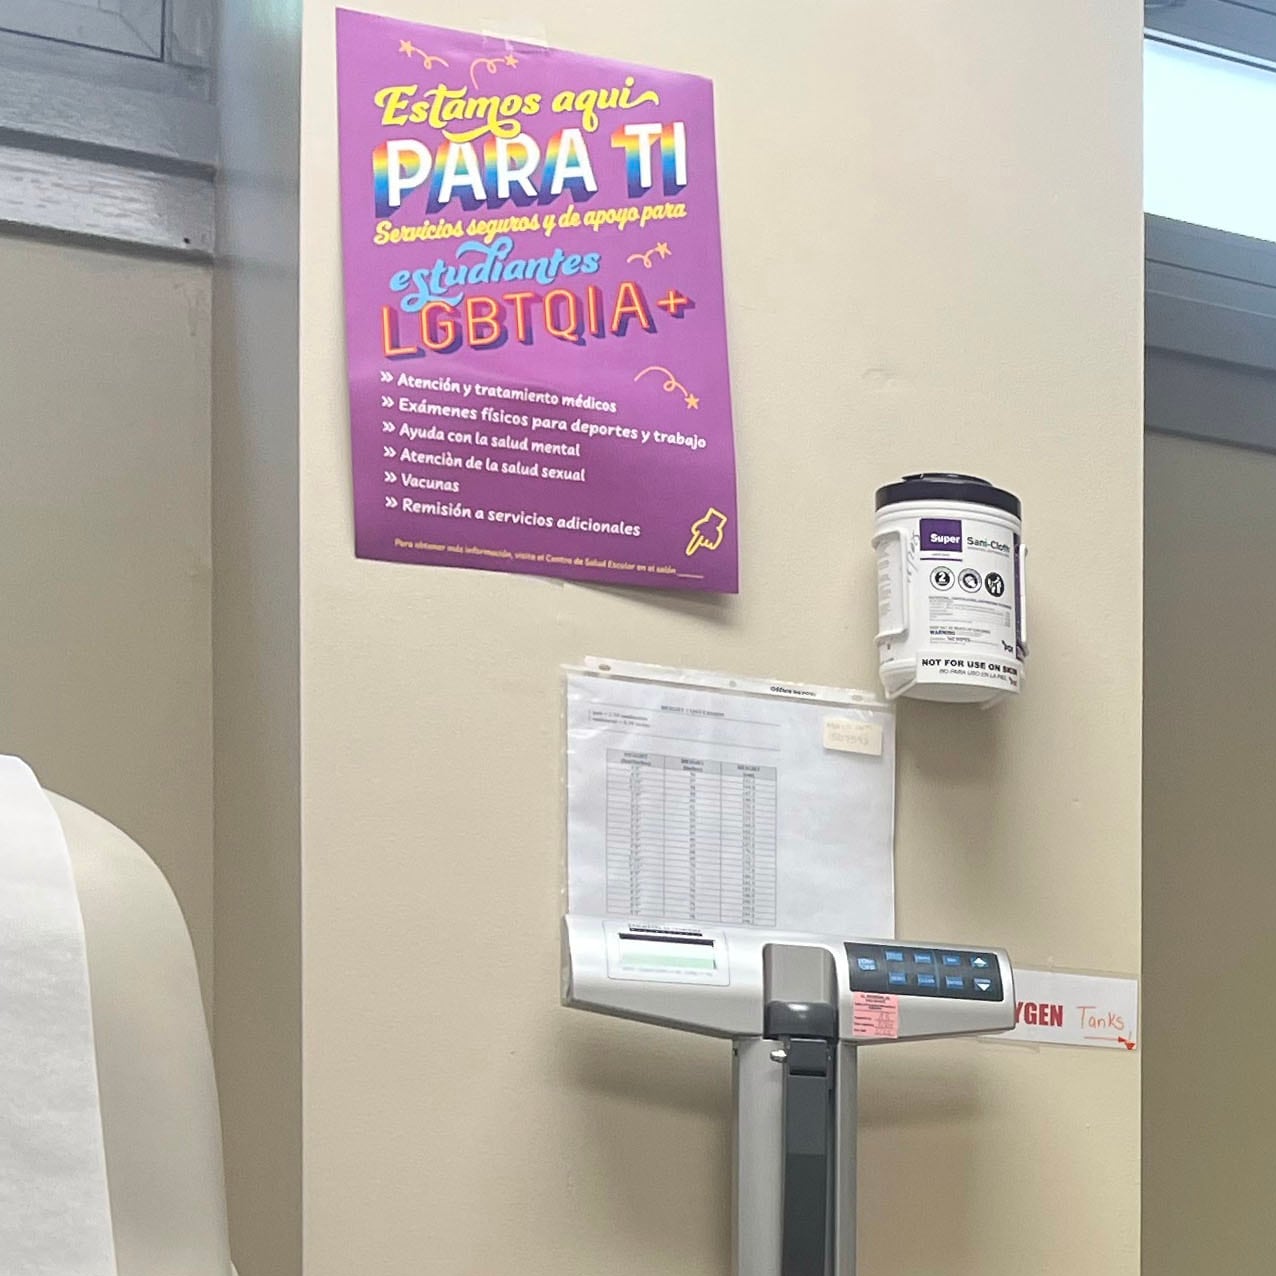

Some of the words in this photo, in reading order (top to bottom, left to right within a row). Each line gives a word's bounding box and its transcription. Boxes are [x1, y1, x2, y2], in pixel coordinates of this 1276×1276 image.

[374, 84, 541, 142] Estamos
[373, 127, 599, 214] PARA
[611, 121, 687, 197] TI
[373, 219, 462, 246] Servicios
[467, 214, 540, 245] seguros
[543, 214, 556, 234] y
[559, 205, 580, 229] de
[583, 207, 640, 233] apoyo
[640, 202, 687, 228] para
[390, 236, 601, 312] estudiantes
[380, 281, 695, 359] LGBTQIA+
[398, 372, 461, 393] Atención
[463, 383, 472, 398] y
[475, 383, 559, 405] tratamiento
[562, 392, 617, 412] médicos
[399, 398, 477, 420] Exámenes
[481, 406, 528, 426] físicos
[532, 415, 558, 431] para
[561, 419, 638, 441] deportes
[641, 429, 650, 444] y
[653, 429, 706, 449] trabajo
[399, 423, 445, 442] Ayuda
[447, 430, 473, 444] con
[475, 430, 488, 445] la
[491, 433, 529, 450] salud
[532, 437, 581, 454] mental
[401, 474, 459, 493] Vacunas
[465, 455, 482, 470] de
[485, 456, 498, 472] la
[501, 458, 539, 477] salud
[541, 462, 586, 482] sexual
[402, 498, 472, 520] Remisión
[475, 509, 484, 520] a
[488, 510, 553, 528] servicios
[557, 515, 641, 537] adicionales
[930, 533, 960, 544] Super
[967, 536, 1010, 553] Sani-Cloth
[938, 571, 946, 582] 2
[945, 659, 964, 667] FOR
[967, 661, 986, 669] USE
[988, 663, 1000, 672] ON
[1015, 1001, 1063, 1027] YGEN
[1076, 1006, 1124, 1031] Tanks
